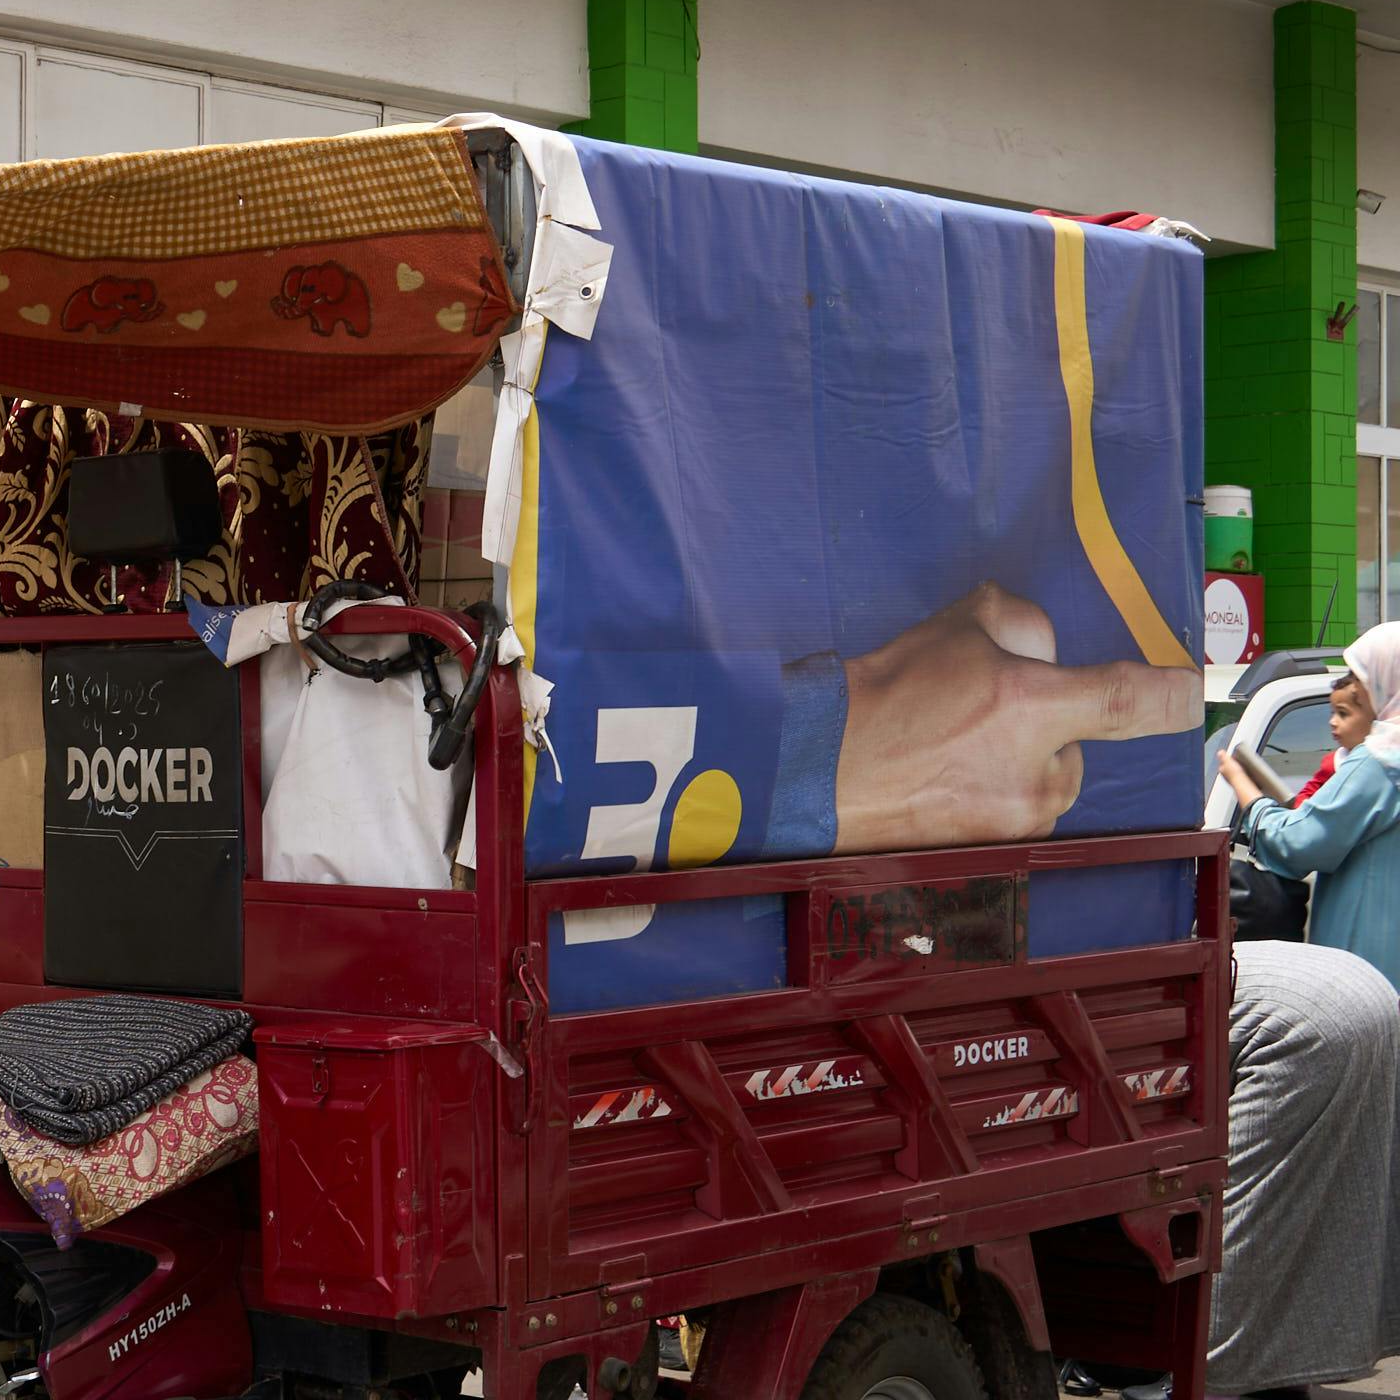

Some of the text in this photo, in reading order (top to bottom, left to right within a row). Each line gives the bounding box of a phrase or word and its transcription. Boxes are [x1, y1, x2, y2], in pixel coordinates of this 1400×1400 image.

[67, 747, 213, 802] DOCKER
[954, 1036, 1028, 1067] DOCKER
[108, 1293, 192, 1362] HY150ZH-A
